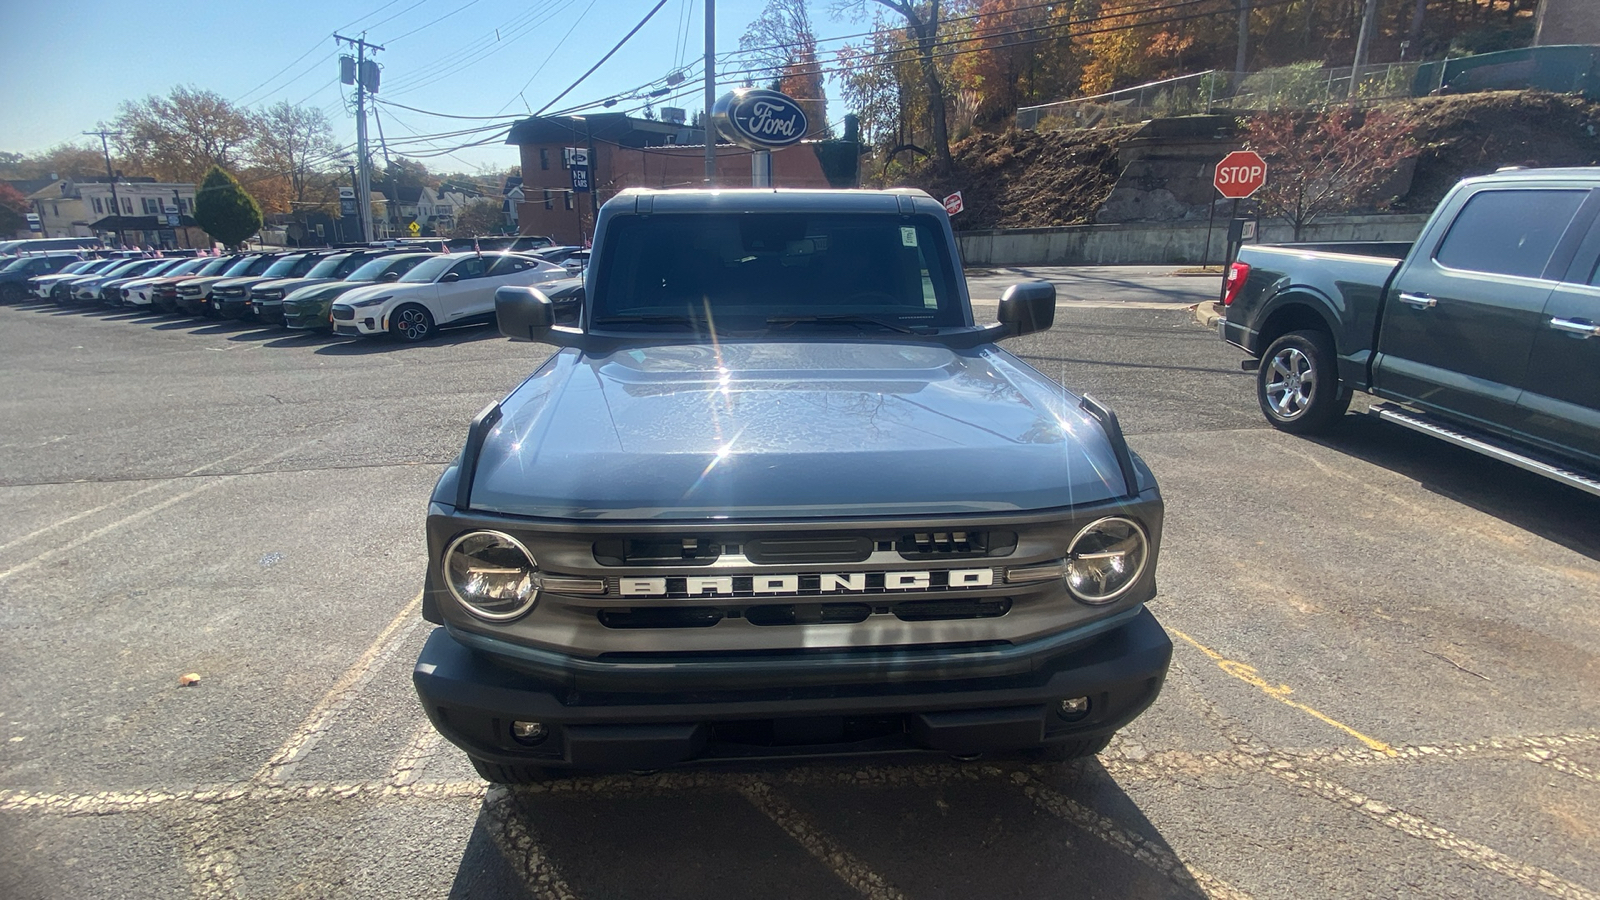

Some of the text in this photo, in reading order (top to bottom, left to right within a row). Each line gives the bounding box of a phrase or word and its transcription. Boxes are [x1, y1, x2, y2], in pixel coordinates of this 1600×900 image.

[749, 101, 796, 136] Ford
[573, 170, 586, 179] NEW
[574, 179, 588, 187] CARS
[1219, 165, 1261, 184] STOP
[619, 568, 994, 595] BRONCO
